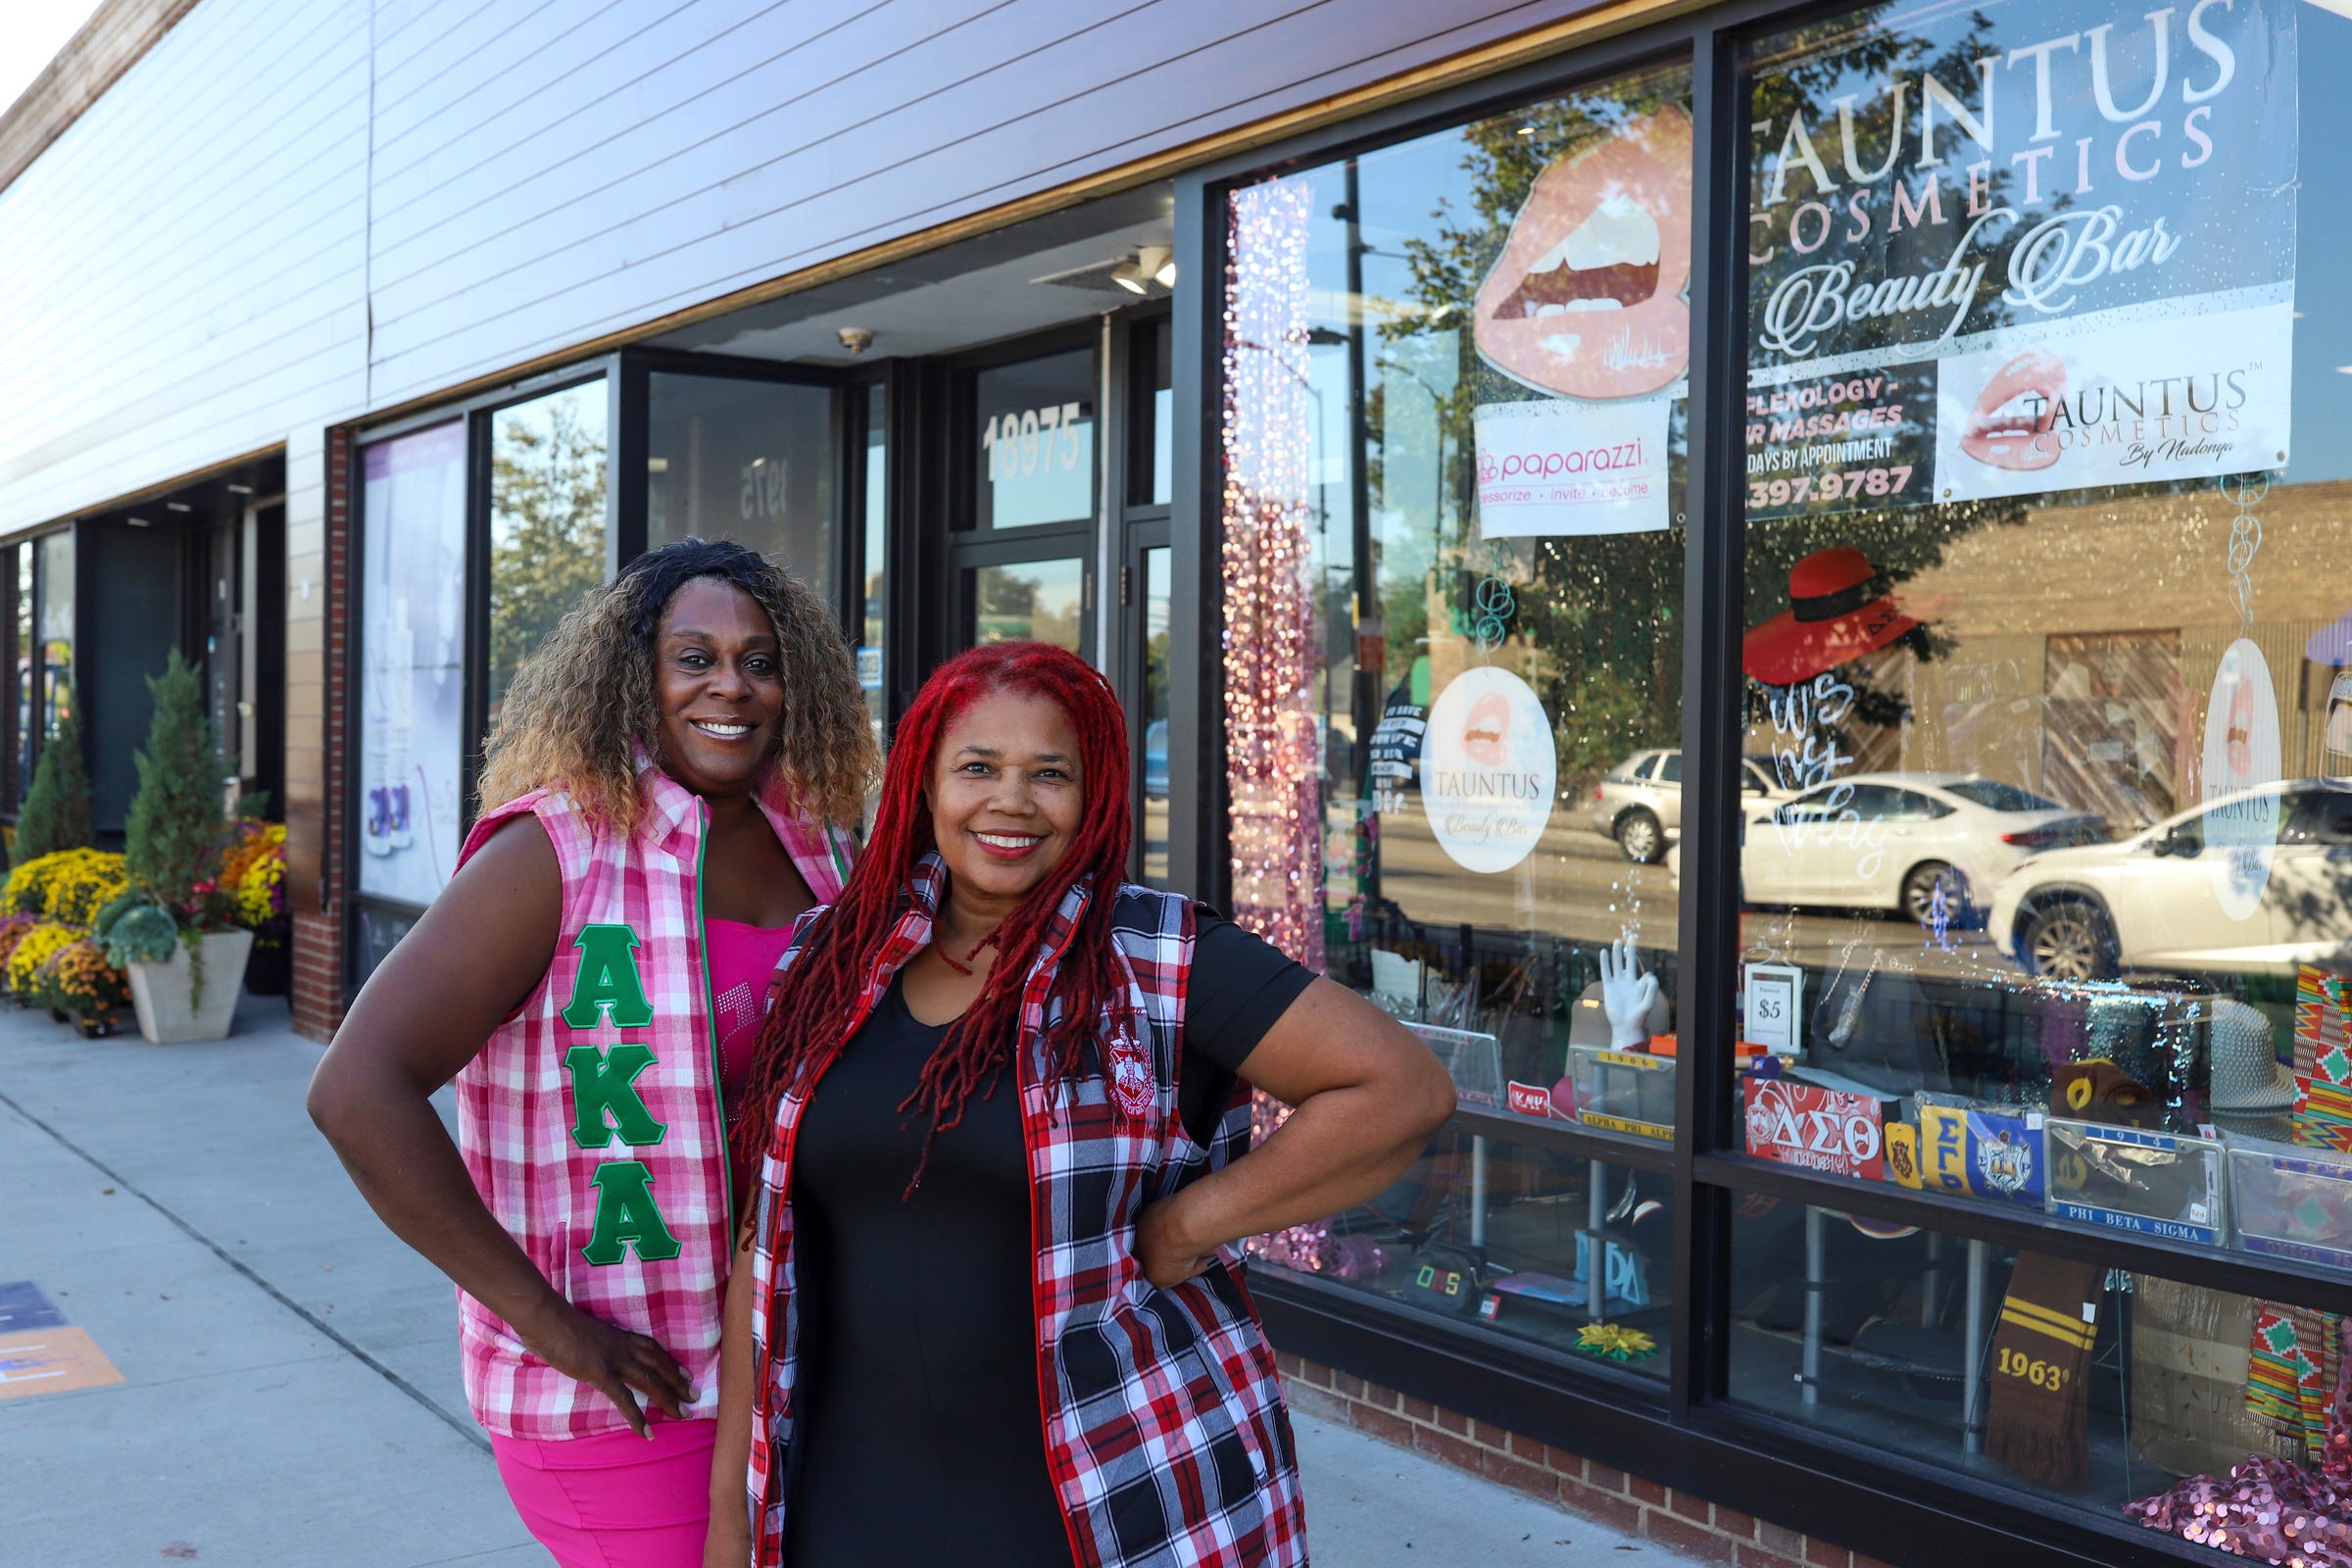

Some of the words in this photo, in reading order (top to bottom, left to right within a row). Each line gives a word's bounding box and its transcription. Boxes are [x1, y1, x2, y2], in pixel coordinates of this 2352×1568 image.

[1751, 0, 2235, 208] AUNTUS
[1759, 207, 2019, 358] Beauty
[2001, 204, 2182, 315] Bar
[2023, 369, 2246, 433] TAUNTUS
[983, 401, 1081, 482] 18975
[1769, 405, 1903, 444] MASSAGES
[2033, 411, 2241, 454] COSMETICS
[1501, 437, 1643, 481] paparazzi
[1747, 452, 1780, 473] DAYS
[1783, 448, 1798, 470] BY
[1800, 437, 1892, 466] APPOINTMENT
[2119, 443, 2155, 468] By
[2156, 438, 2234, 463] Nadonya
[1480, 487, 1532, 506] essorize
[1550, 485, 1587, 501] invite
[1435, 771, 1540, 801] TAUNTUS
[2209, 783, 2270, 823] TAUNTUS
[1445, 811, 1493, 845] Beauty
[1758, 998, 1781, 1020] $5
[561, 923, 682, 1265] AKA
[1587, 1115, 1616, 1130] ALPHA
[1624, 1122, 1642, 1133] PHI
[1772, 1105, 1882, 1160] ΔΣΘ
[2069, 1205, 2093, 1221] PHI
[2106, 1212, 2141, 1231] BETA
[2154, 1220, 2199, 1241] SIGMA
